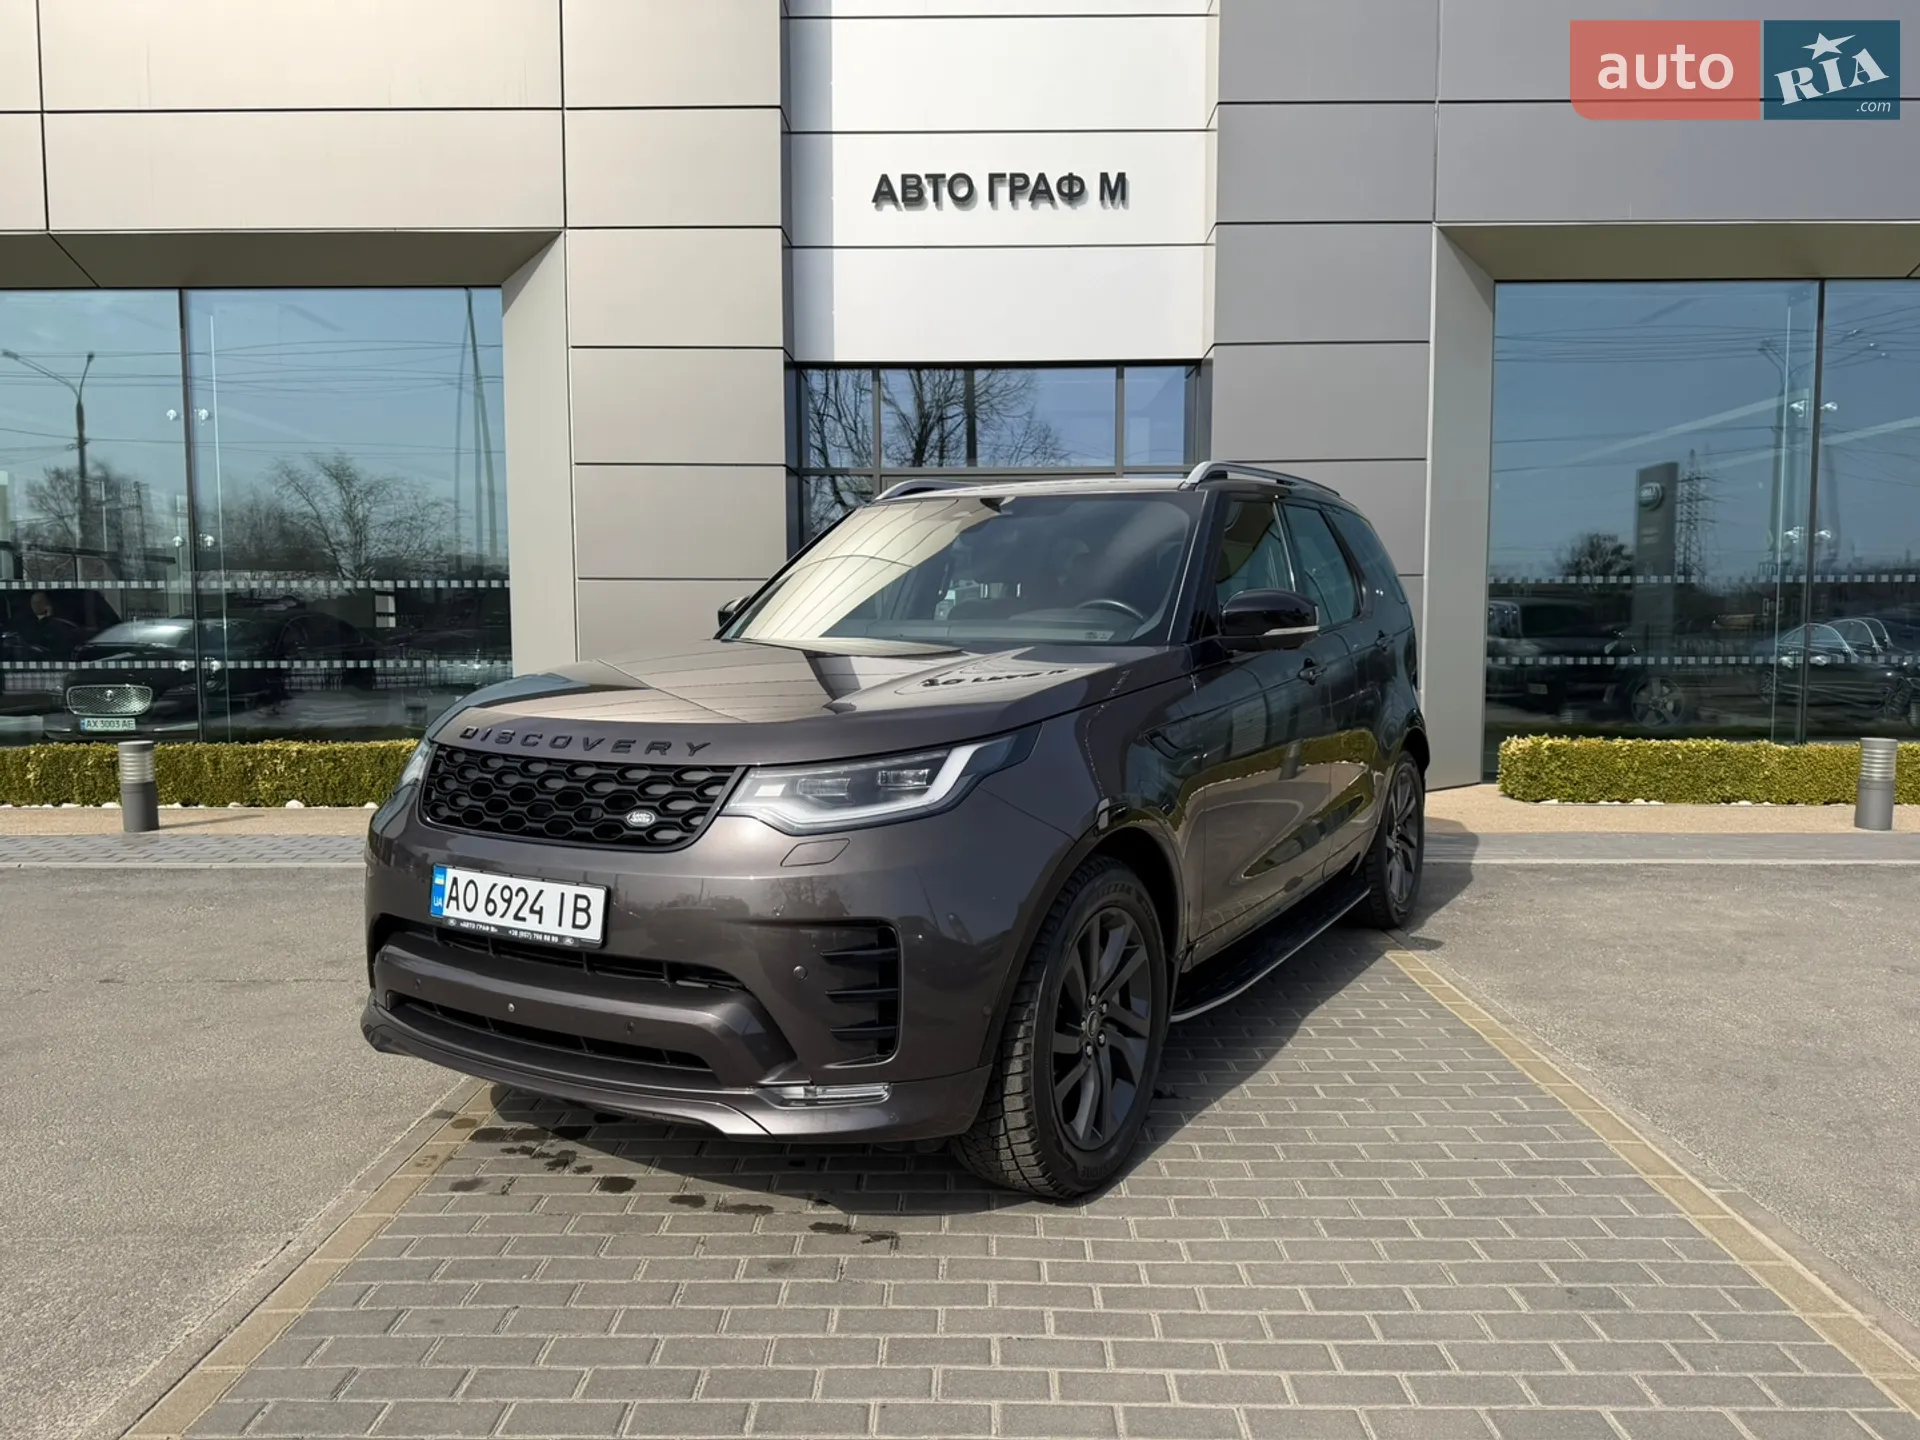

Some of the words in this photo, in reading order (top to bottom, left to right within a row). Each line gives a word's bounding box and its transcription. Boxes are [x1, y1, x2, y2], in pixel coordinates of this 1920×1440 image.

[871, 172, 975, 203] АВТО
[988, 171, 1086, 203] ГРАФ
[1099, 171, 1127, 202] М
[459, 725, 711, 756] DISCOVERY
[433, 896, 443, 908] UA
[446, 876, 479, 913] AO
[484, 883, 544, 925] 6924
[557, 892, 592, 931] IB
